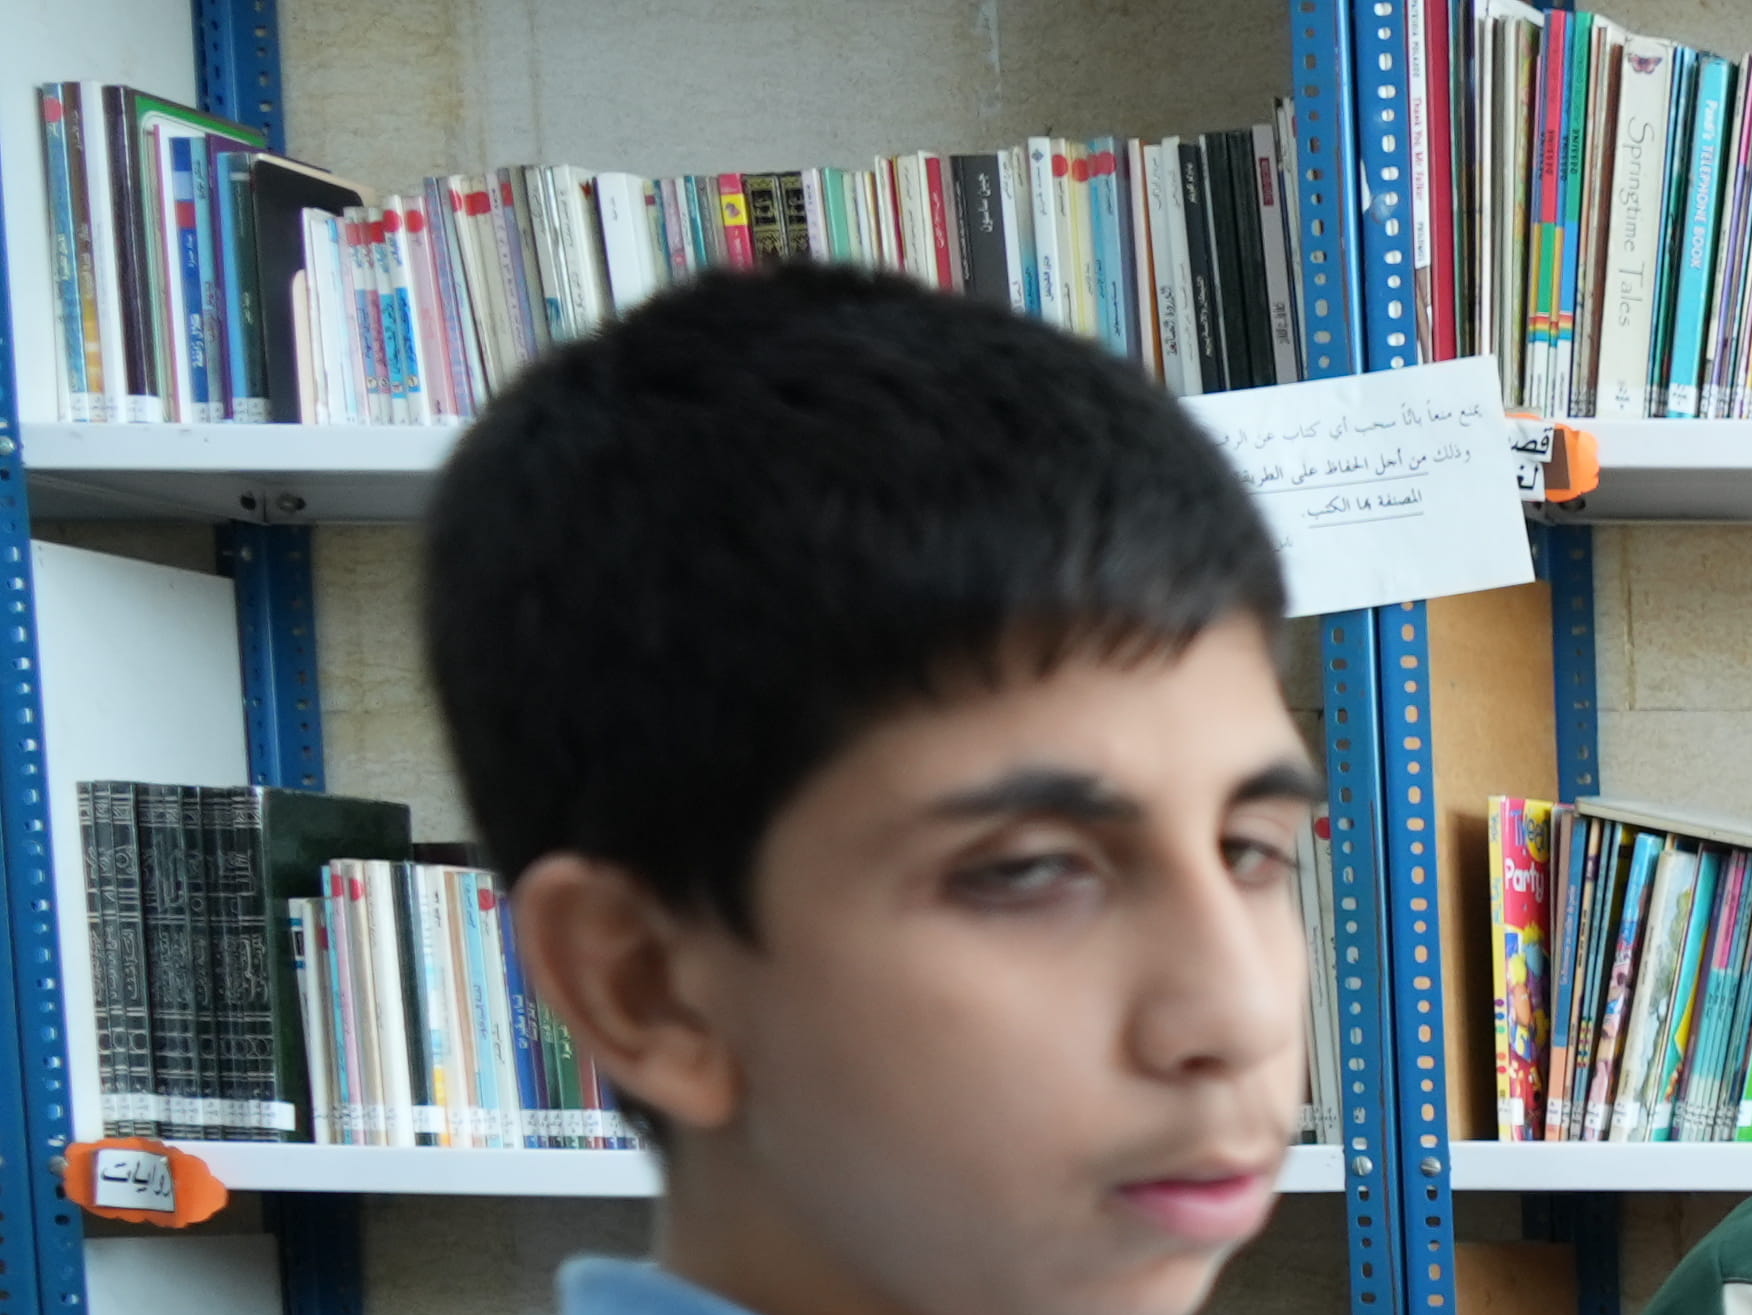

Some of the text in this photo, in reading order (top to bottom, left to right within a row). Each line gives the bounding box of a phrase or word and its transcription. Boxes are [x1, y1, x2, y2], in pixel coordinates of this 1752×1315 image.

[1411, 96, 1424, 127] Thank
[1694, 143, 1714, 221] TELEPHONE
[974, 174, 995, 232] جين ساسون
[1617, 116, 1657, 327] Springtime Tales
[1690, 224, 1707, 268] BOOK
[1282, 419, 1322, 442] كتاب
[1328, 414, 1349, 440] أي
[1355, 416, 1397, 435] سحب
[1254, 430, 1276, 450] عن
[1509, 427, 1554, 455] قص
[1325, 455, 1370, 477] الحفاظ
[1408, 452, 1429, 473] من
[1432, 447, 1473, 465] وذلك
[1290, 465, 1319, 487] على
[1516, 464, 1539, 490] لغ
[1377, 489, 1425, 509] المصنفة
[1505, 858, 1545, 902] Party
[100, 1161, 172, 1198] روايات
